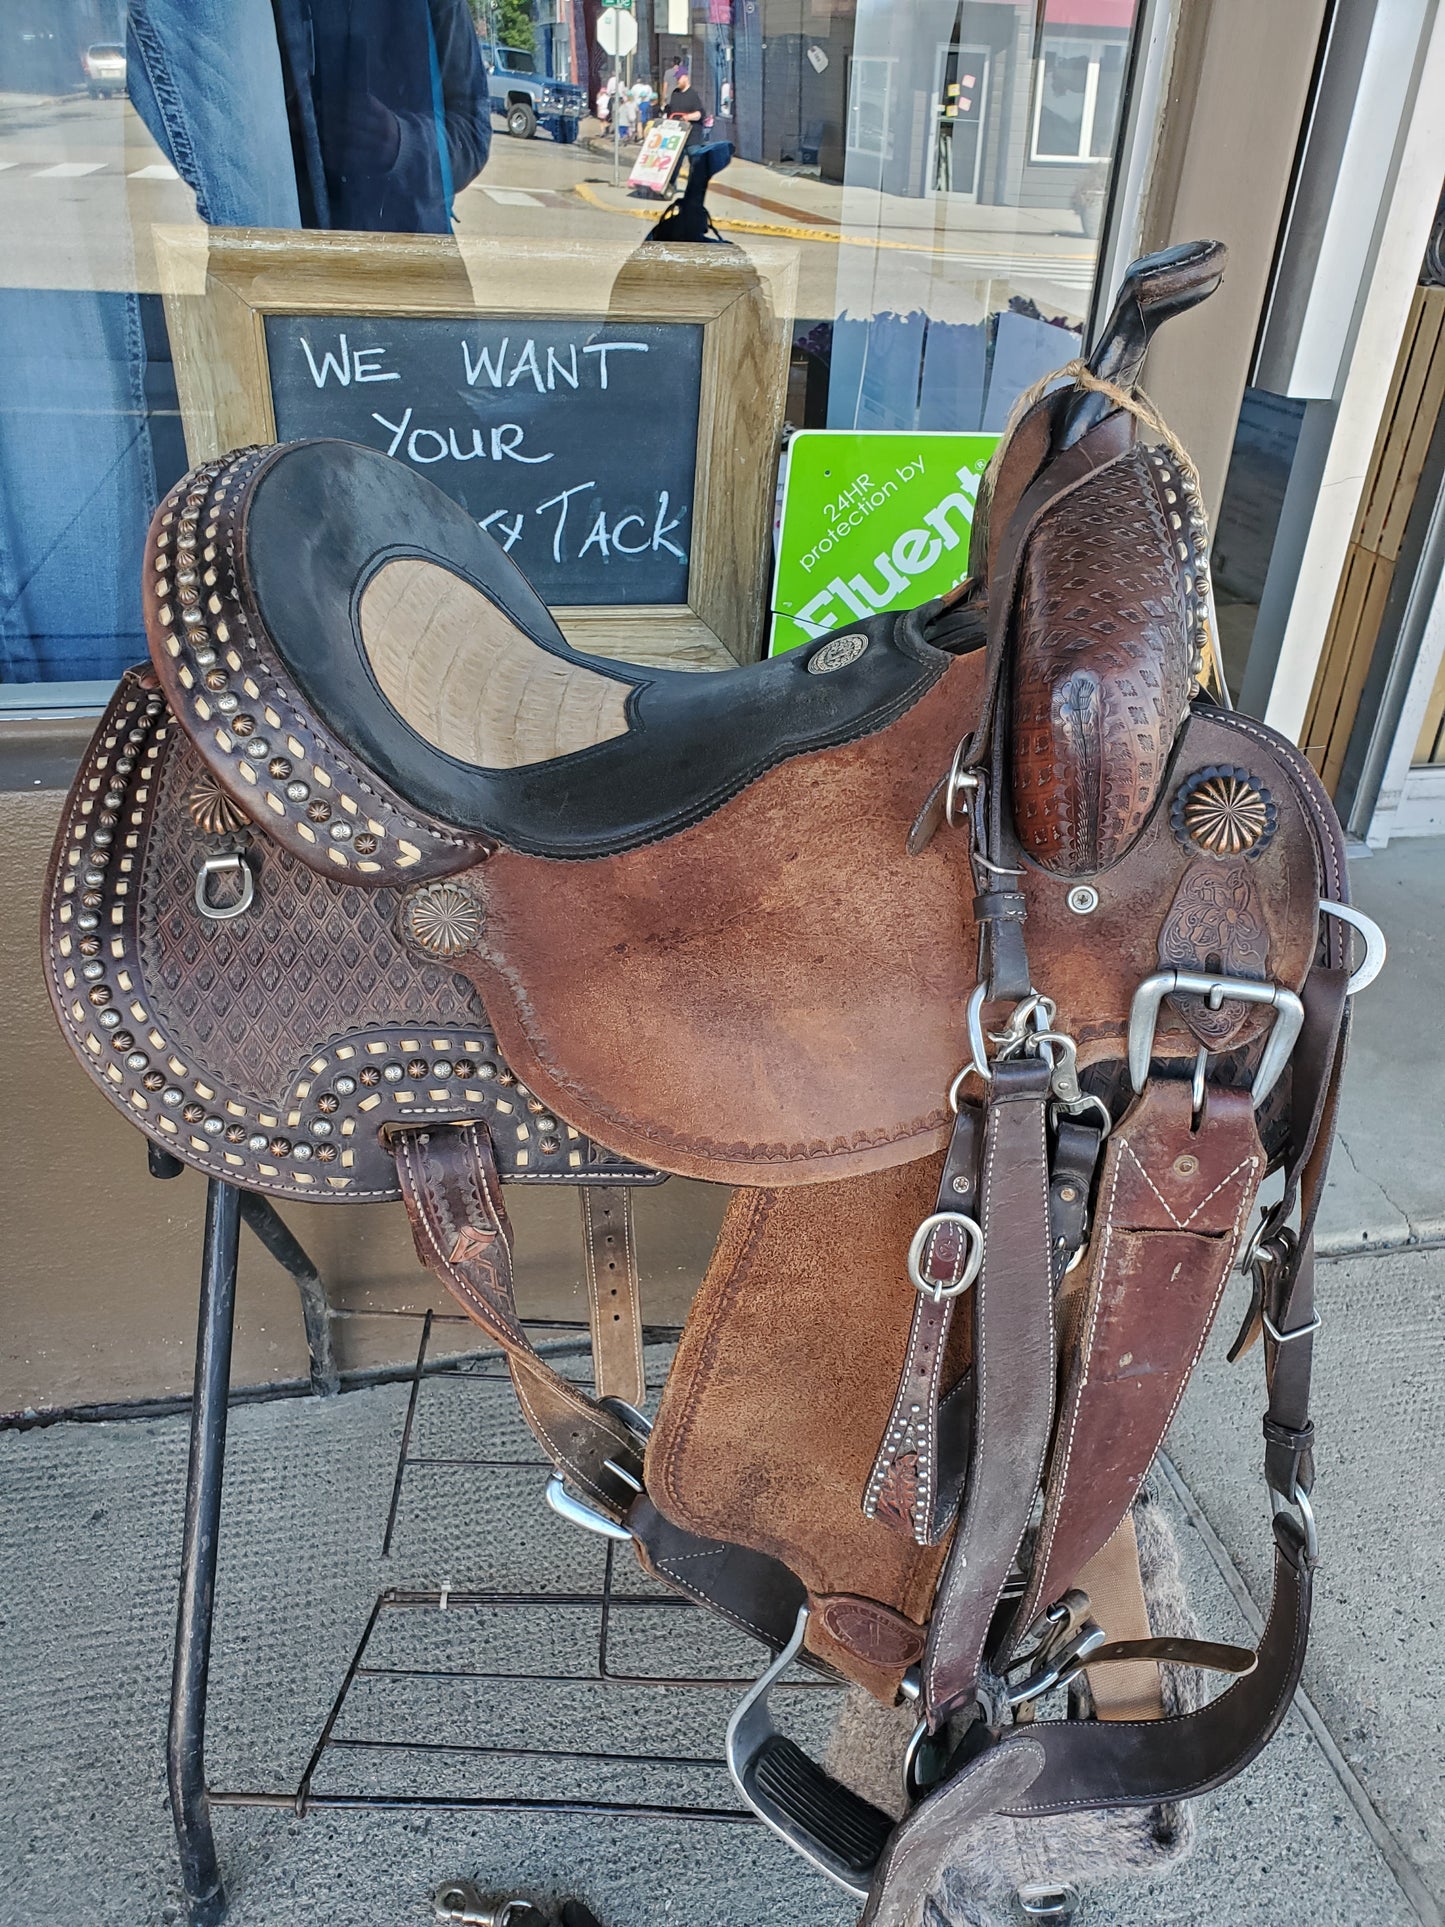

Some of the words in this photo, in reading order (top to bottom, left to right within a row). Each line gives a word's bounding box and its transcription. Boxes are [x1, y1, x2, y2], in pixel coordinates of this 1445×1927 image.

[300, 333, 401, 389] WE
[461, 337, 649, 393] WANT
[371, 408, 555, 464] YOUR
[799, 480, 899, 573] protection
[895, 454, 926, 483] by
[823, 473, 876, 523] 24HR
